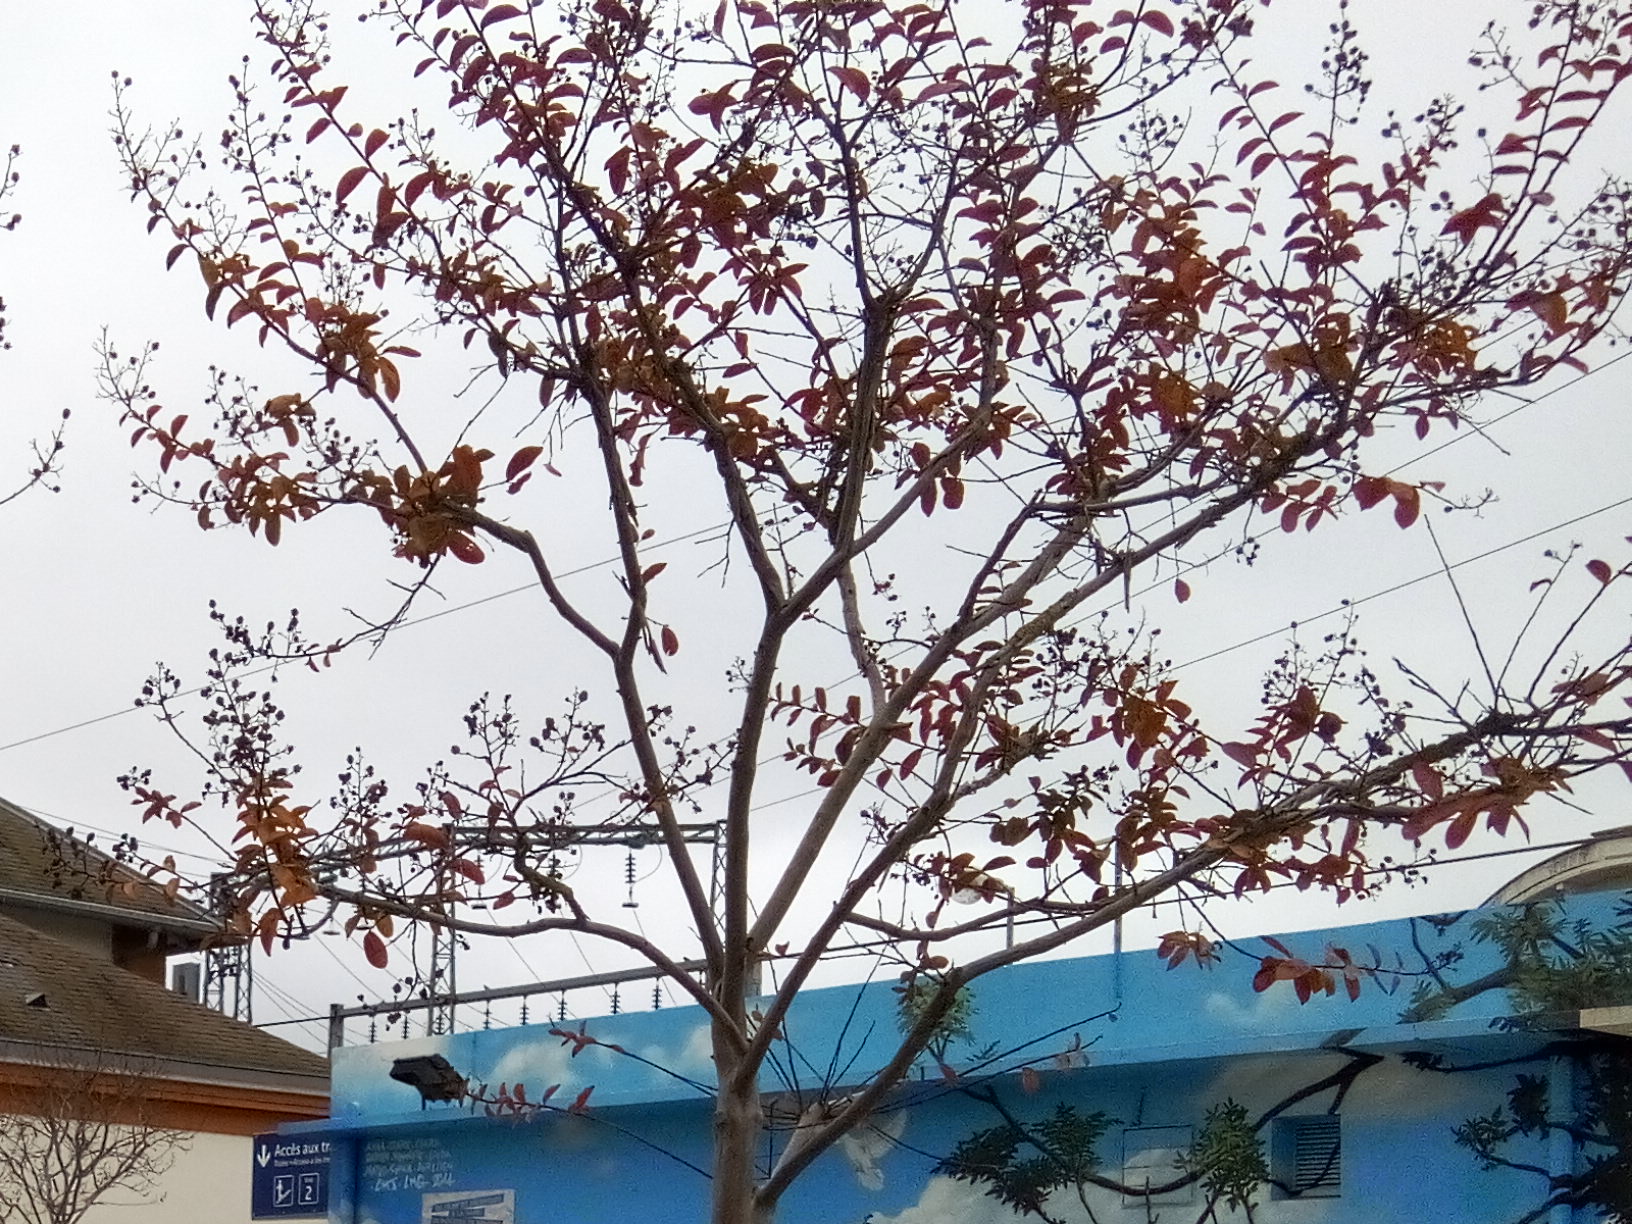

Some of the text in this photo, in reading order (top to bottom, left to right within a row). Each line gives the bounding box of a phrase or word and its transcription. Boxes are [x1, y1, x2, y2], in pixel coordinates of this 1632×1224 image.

[274, 1143, 301, 1157] Accès
[302, 1144, 319, 1155] aux
[305, 1185, 313, 1201] 2
